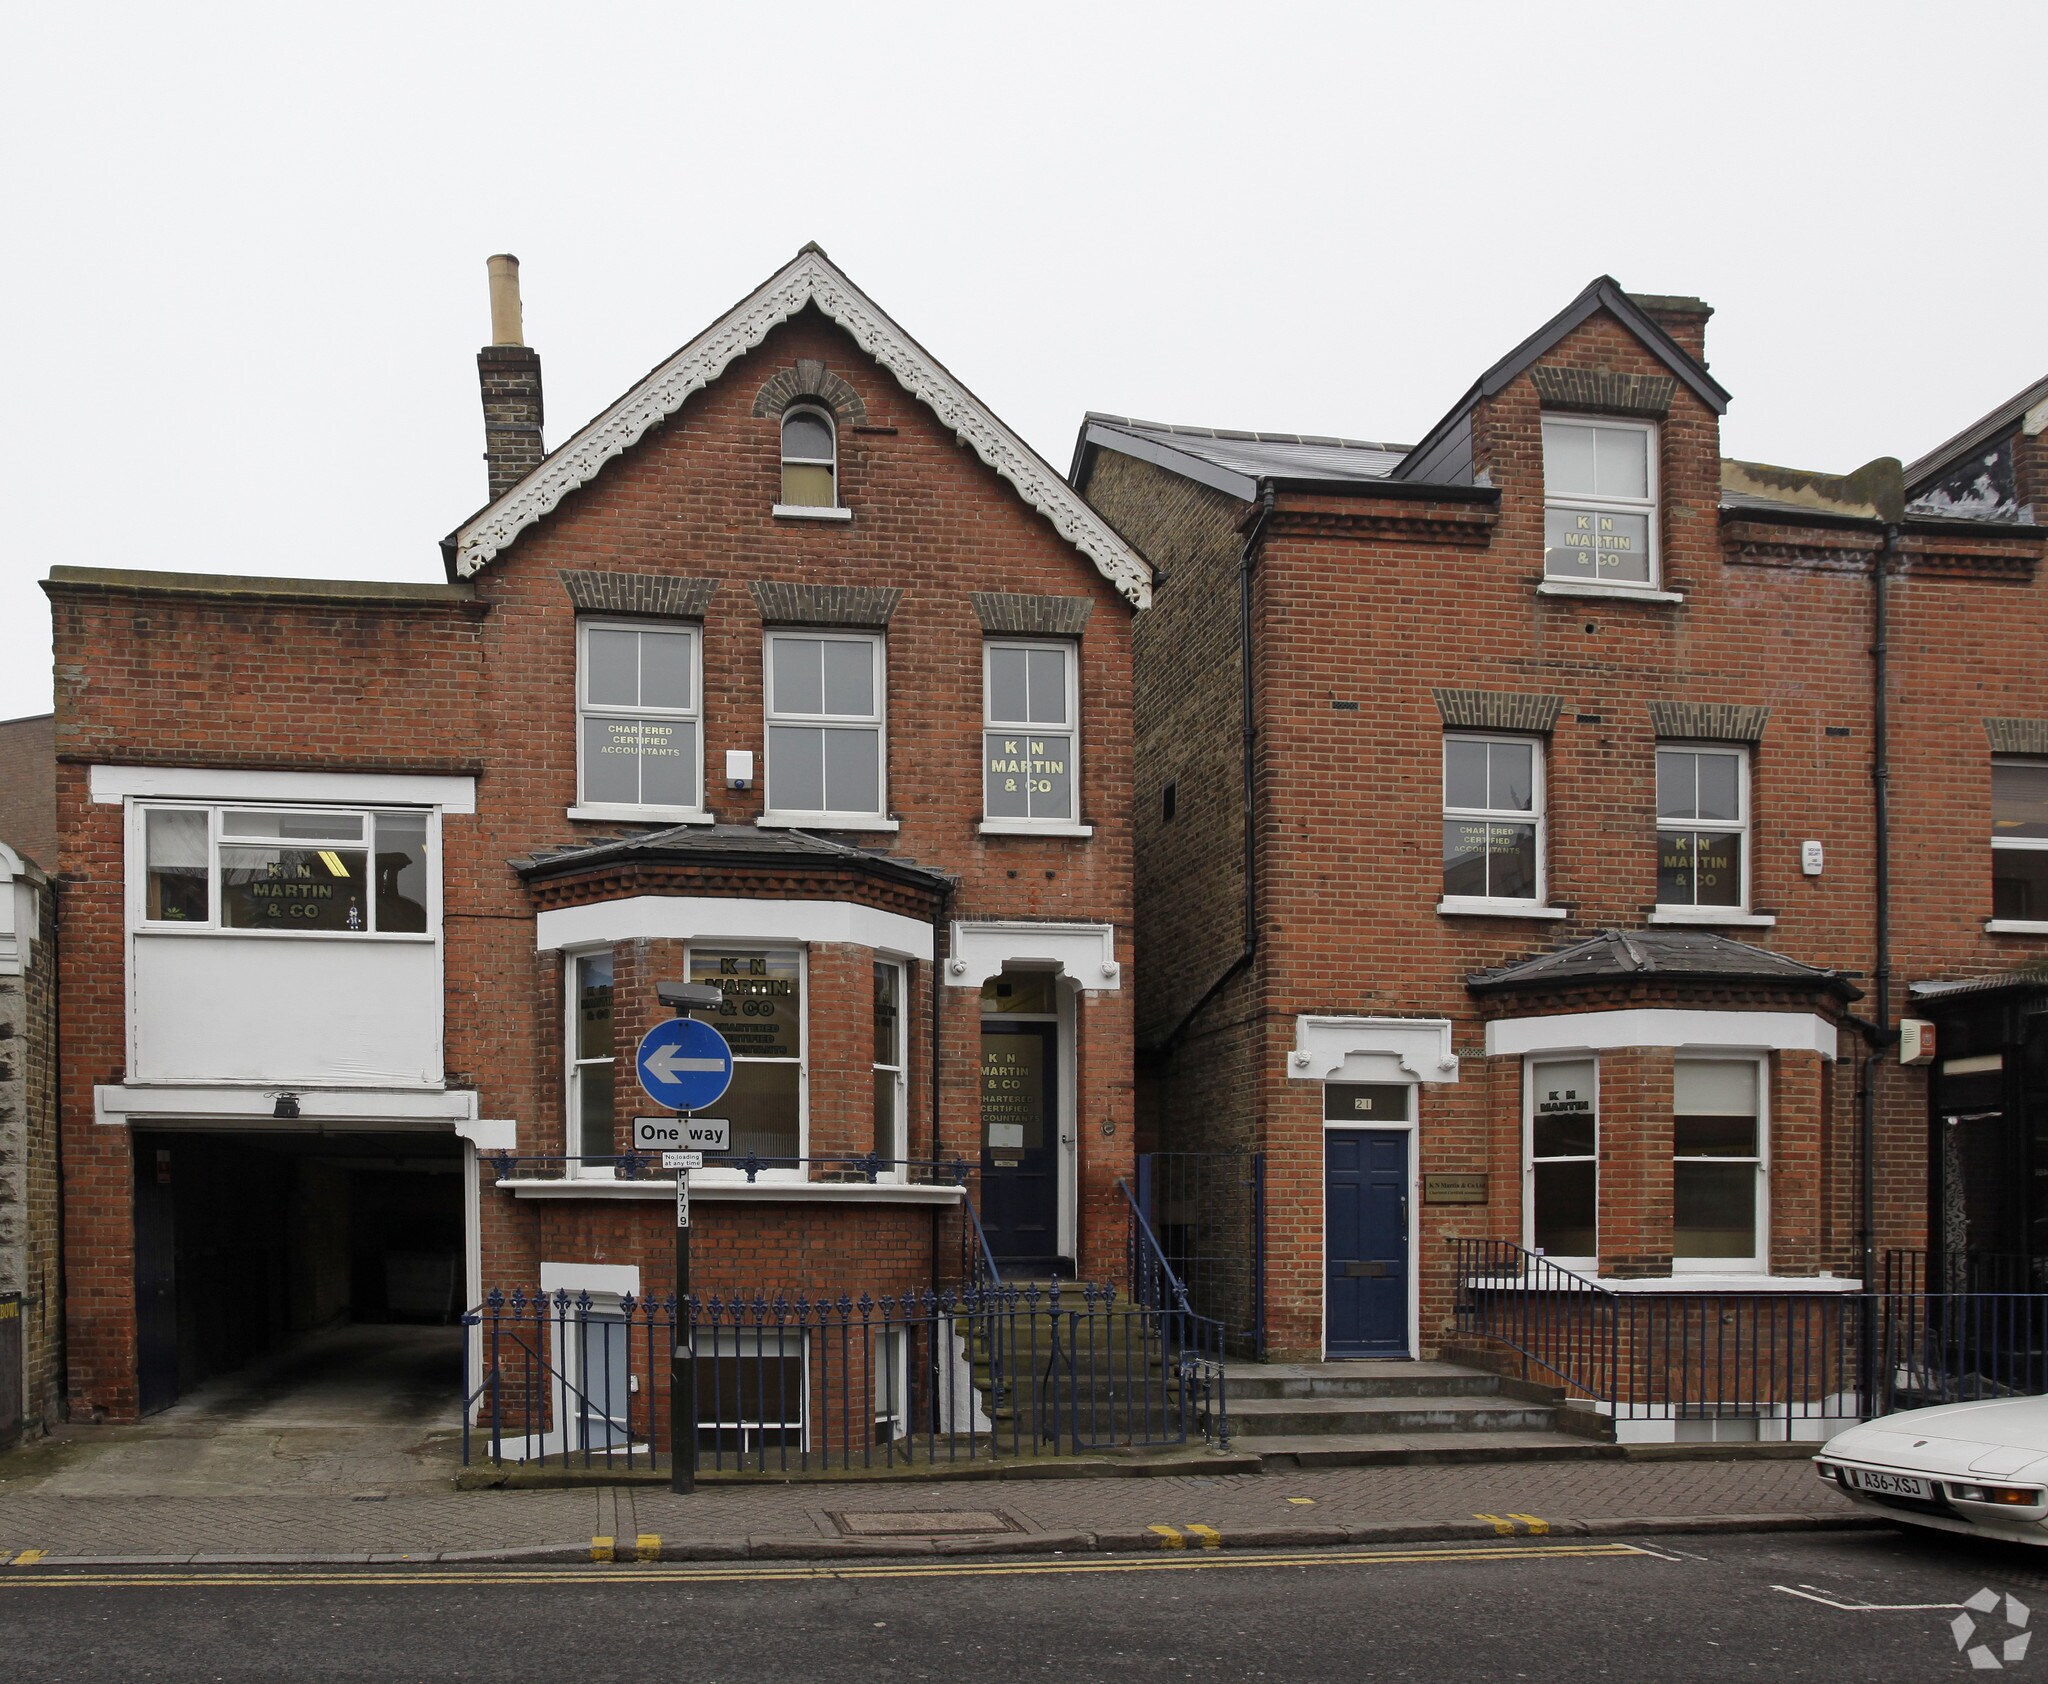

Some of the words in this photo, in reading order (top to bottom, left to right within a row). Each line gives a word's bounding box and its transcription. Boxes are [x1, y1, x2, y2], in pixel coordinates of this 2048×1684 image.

[1577, 516, 1590, 530] K
[1601, 518, 1613, 531] N
[1565, 533, 1631, 550] MARTIN
[1577, 551, 1590, 565] &
[1598, 552, 1620, 567] CO
[608, 725, 673, 735] CHARTERED
[612, 736, 668, 746] CERTIFIED
[1004, 741, 1018, 754] K
[1031, 742, 1044, 755] N
[600, 746, 680, 757] ACCOUNTANTS
[991, 760, 1064, 774] MARTIN
[1004, 778, 1018, 792] &
[1025, 779, 1052, 793] CO
[1459, 826, 1514, 835] CHARERED
[1464, 836, 1510, 845] CERTFIED
[1675, 838, 1687, 850] K
[1698, 838, 1710, 851] N
[1663, 855, 1728, 869] MARTIN
[267, 863, 283, 878] K
[297, 864, 311, 878] N
[1675, 873, 1687, 886] &
[1696, 874, 1717, 887] CO
[253, 883, 333, 899] MARTIN
[267, 903, 282, 918] &
[289, 904, 319, 919] CO
[721, 958, 738, 974] K
[750, 959, 766, 975] N
[720, 1000, 737, 1016] &
[743, 1000, 774, 1016] CO
[988, 1053, 998, 1063] K
[1006, 1053, 1016, 1063] N
[980, 1066, 1029, 1076] MARTIN
[987, 1080, 998, 1089] &
[1001, 1080, 1021, 1089] CO
[982, 1095, 1033, 1104] HARTERED
[1549, 1091, 1560, 1100] K
[1356, 1099, 1369, 1109] 21
[1540, 1101, 1589, 1112] MARTIN
[641, 1124, 679, 1140] One
[689, 1128, 723, 1144] way
